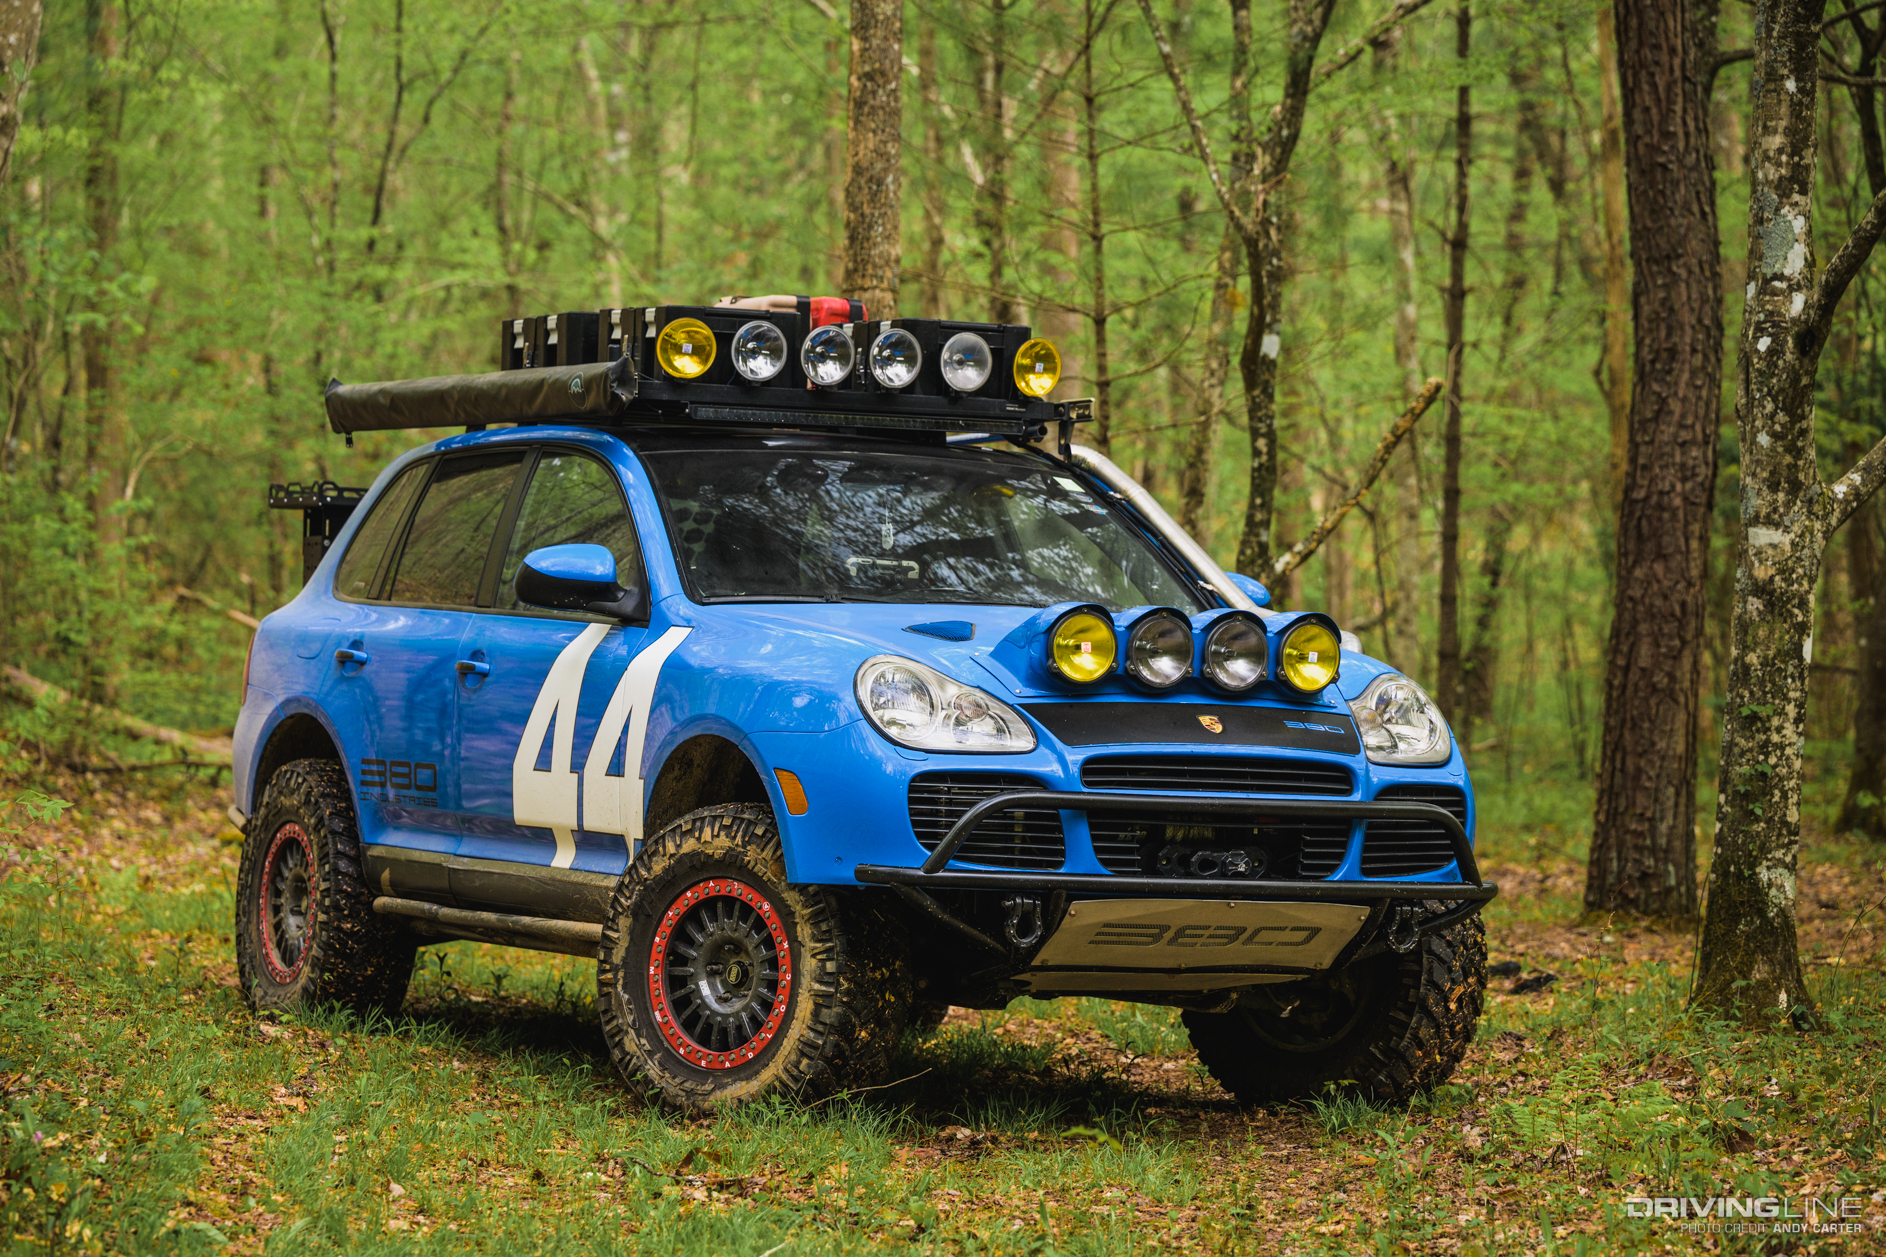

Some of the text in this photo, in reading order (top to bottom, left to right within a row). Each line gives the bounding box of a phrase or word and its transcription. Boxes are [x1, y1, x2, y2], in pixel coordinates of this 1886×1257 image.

[1283, 720, 1345, 734] 380
[513, 623, 694, 868] 44
[360, 758, 438, 793] 380
[360, 791, 439, 807] INDUSTRIES
[1087, 922, 1322, 948] 380
